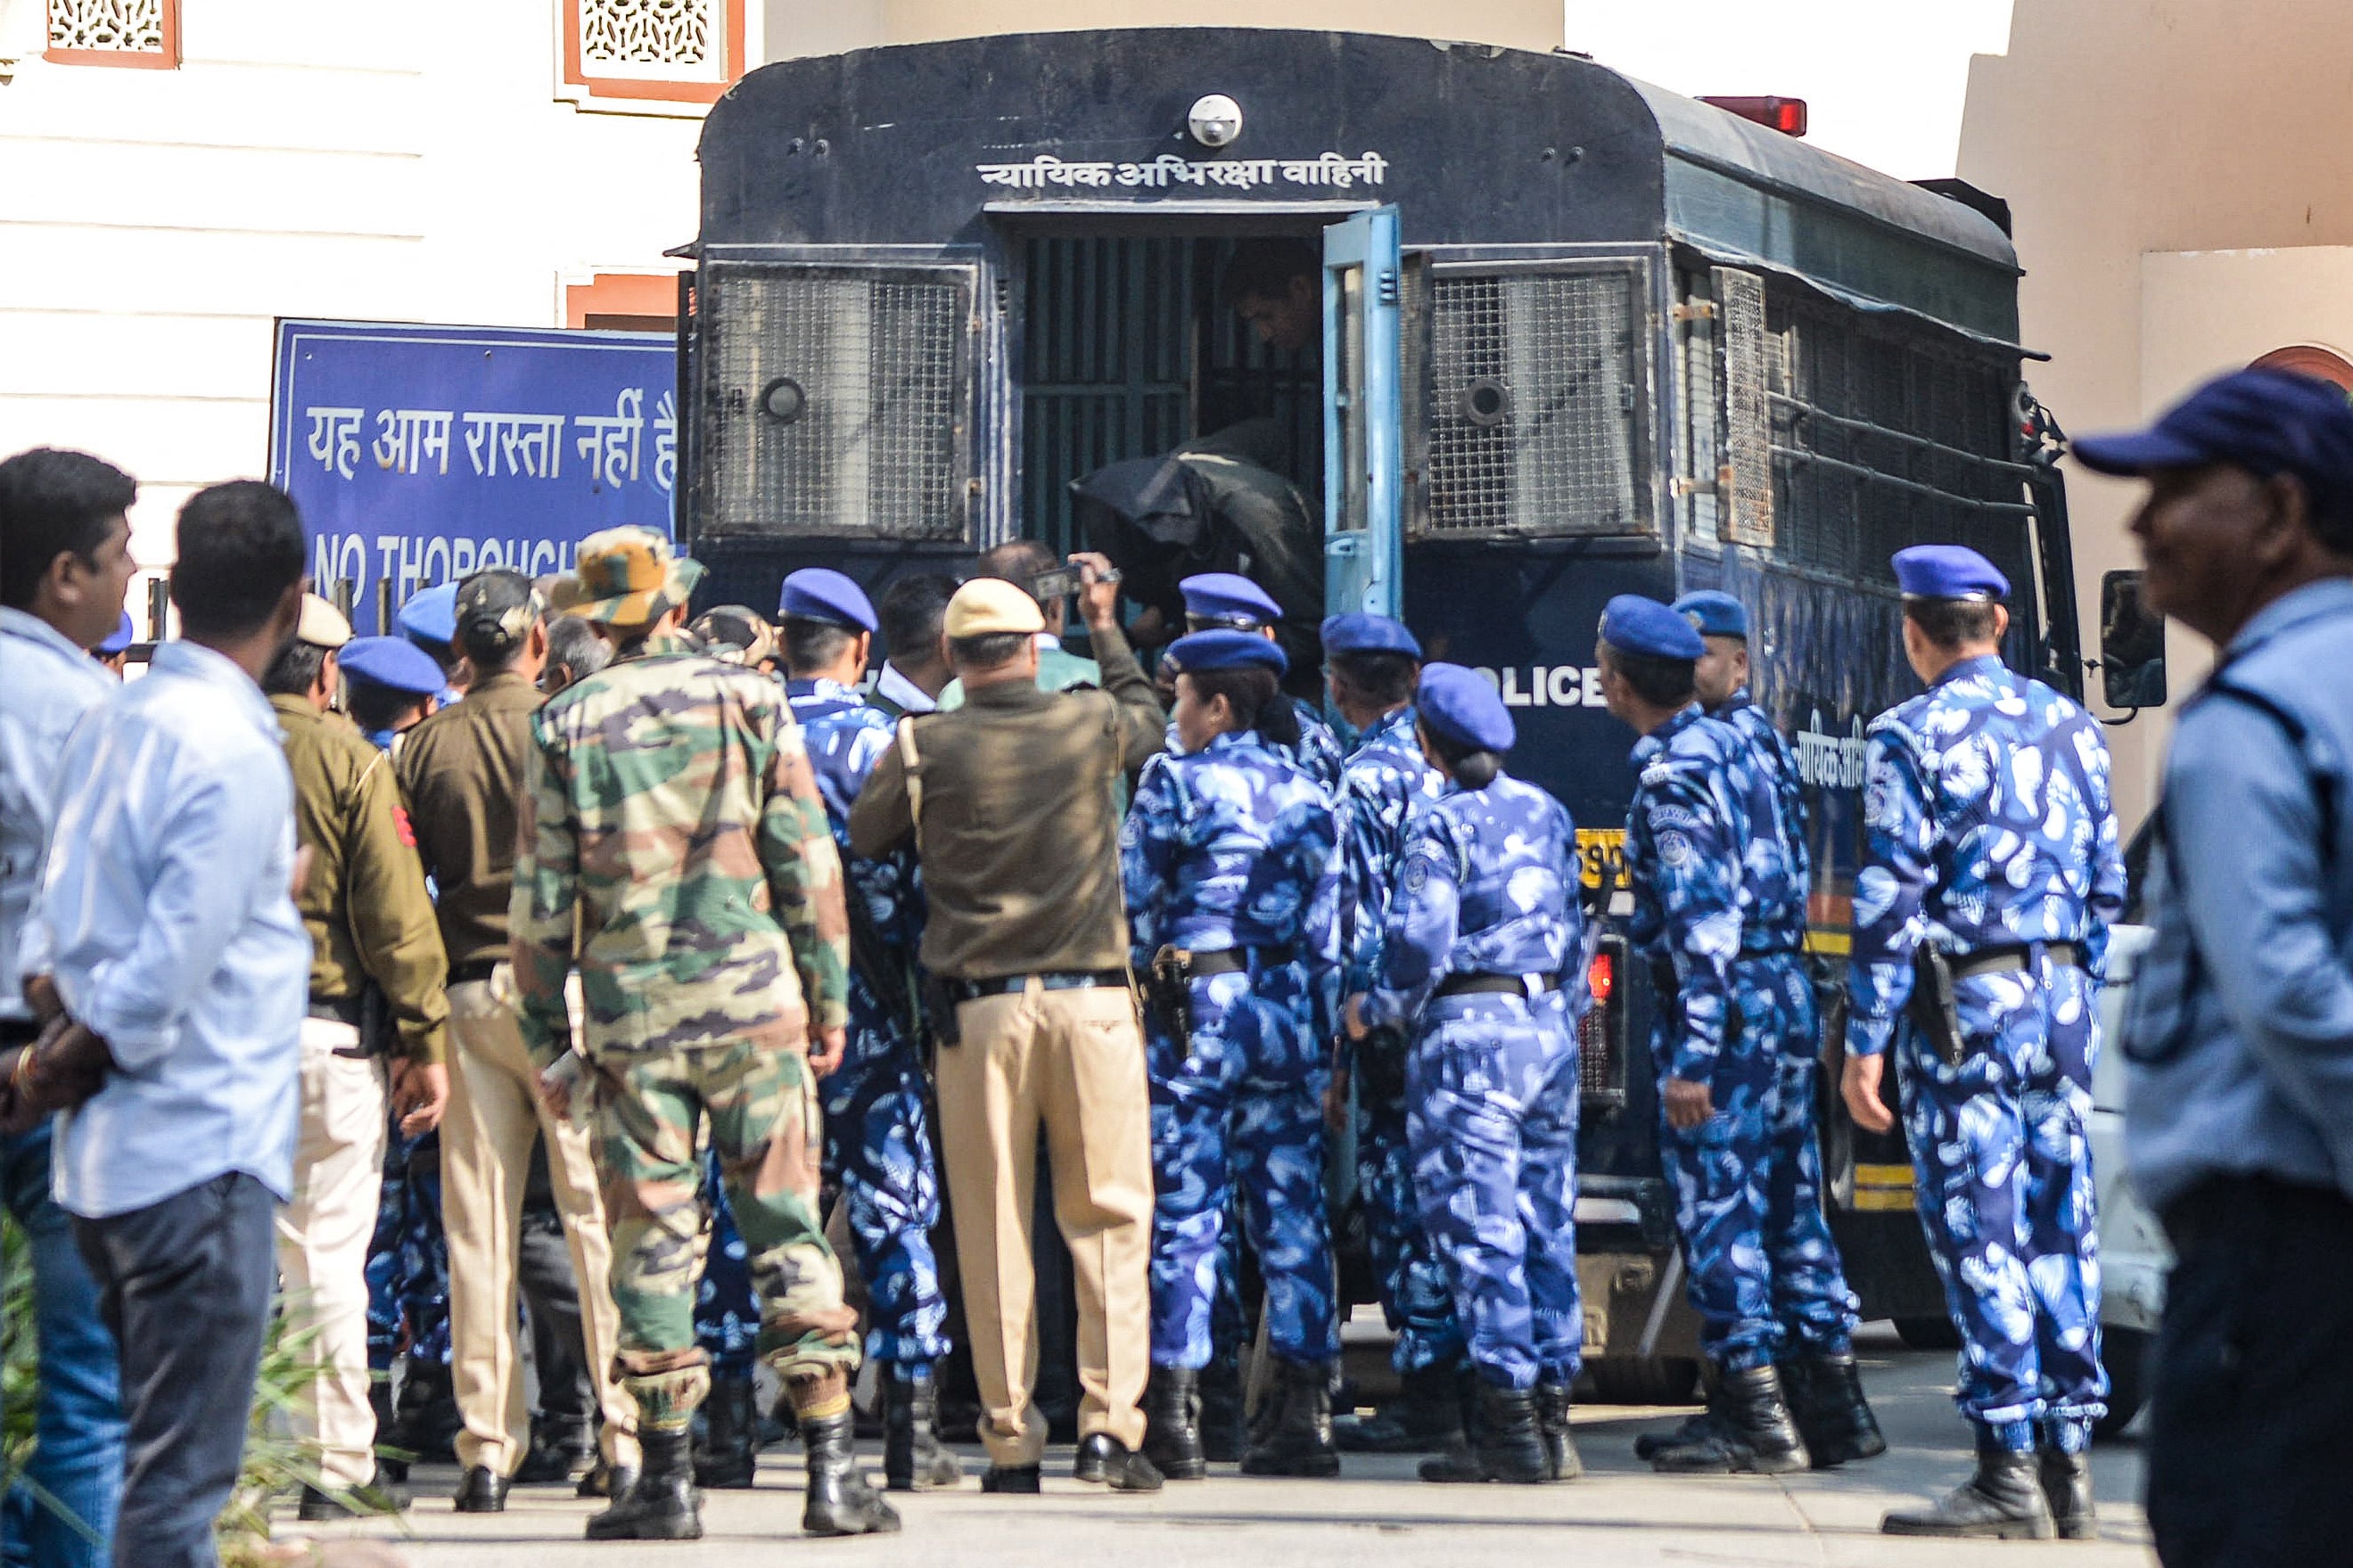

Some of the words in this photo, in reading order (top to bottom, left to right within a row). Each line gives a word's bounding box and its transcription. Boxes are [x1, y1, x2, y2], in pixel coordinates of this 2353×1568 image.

[976, 154, 1112, 189] न्यायिक
[1115, 154, 1277, 190] अभिरक्षा
[1281, 152, 1388, 189] वाहिनी
[307, 406, 365, 480] यह
[372, 408, 454, 475] आम
[463, 412, 565, 478] रास्ता
[574, 388, 644, 488] नहीं
[315, 533, 366, 609] NO
[1472, 666, 1608, 707] LICE
